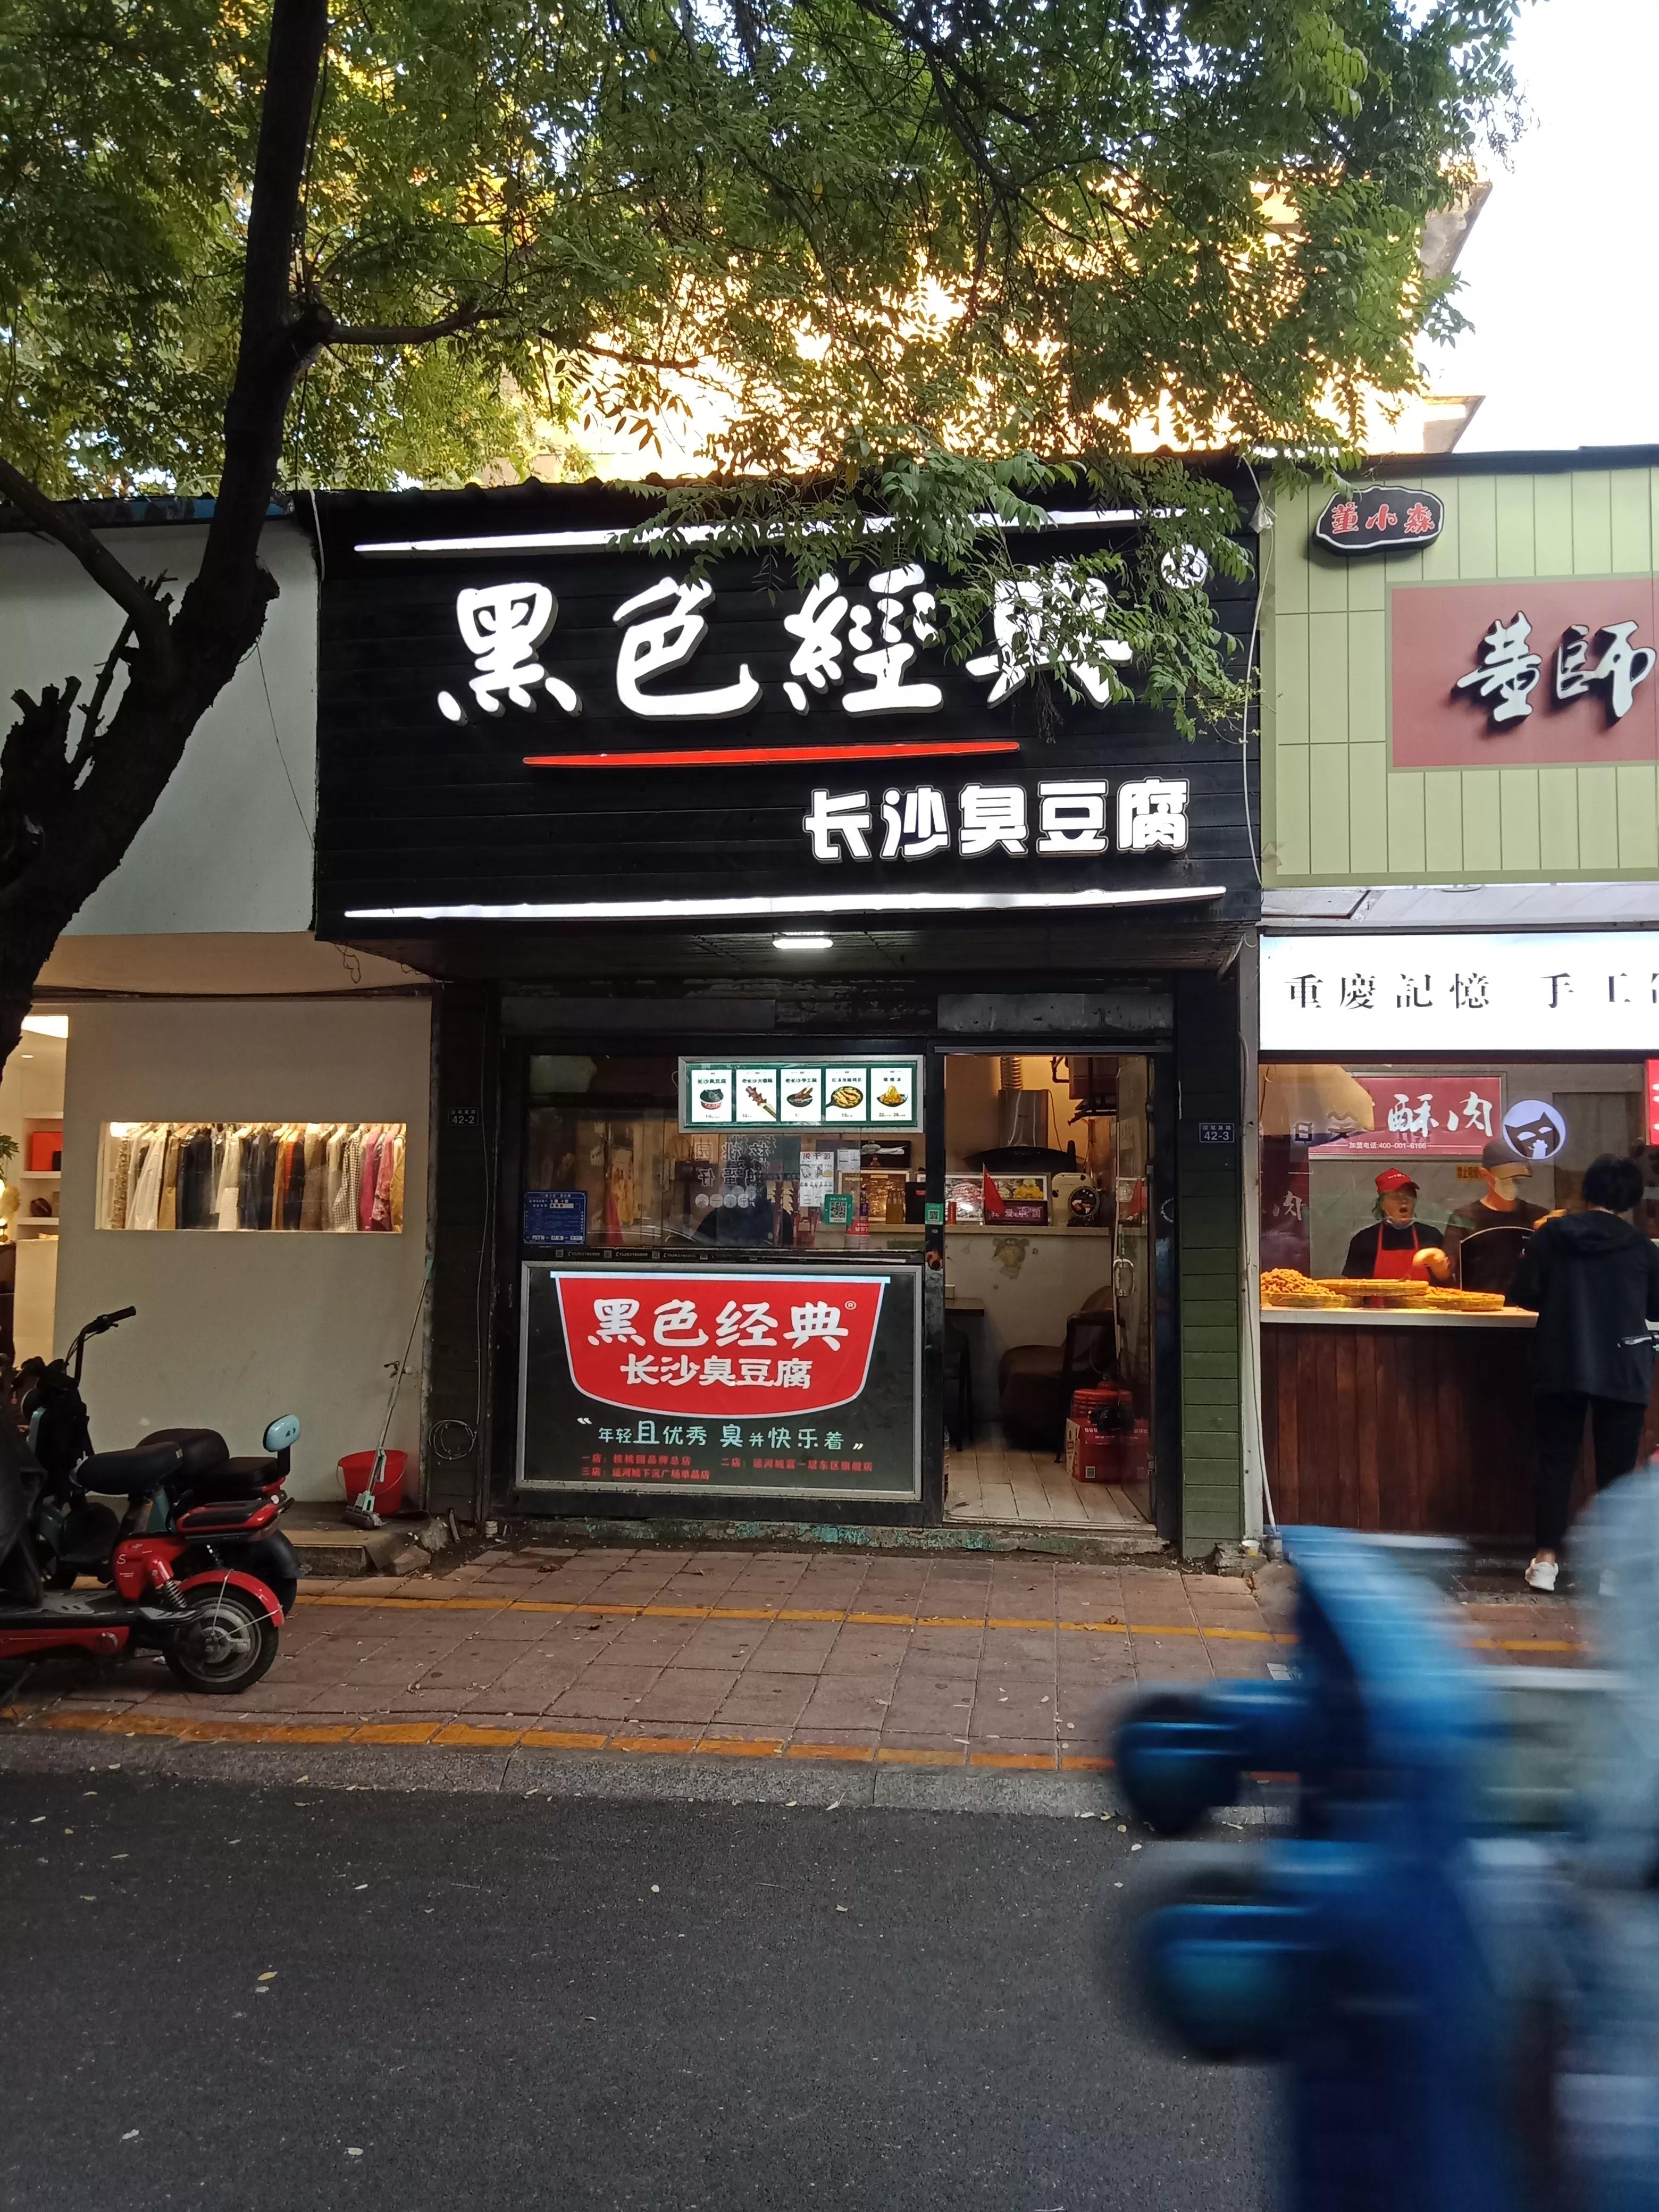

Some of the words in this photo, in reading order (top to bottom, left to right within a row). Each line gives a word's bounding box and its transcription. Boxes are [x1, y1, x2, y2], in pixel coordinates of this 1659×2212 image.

[1331, 501, 1435, 534] 董小森
[803, 776, 1191, 864] 长沙臭豆腐
[1285, 972, 1489, 1010] 重慶記憶
[451, 1116, 475, 1124] 42-2
[1372, 1091, 1493, 1138] 酥肉
[1203, 1131, 1229, 1141] 42-3
[587, 1298, 850, 1352] 黑色经典
[619, 1353, 813, 1389] 长沙臭豆腐
